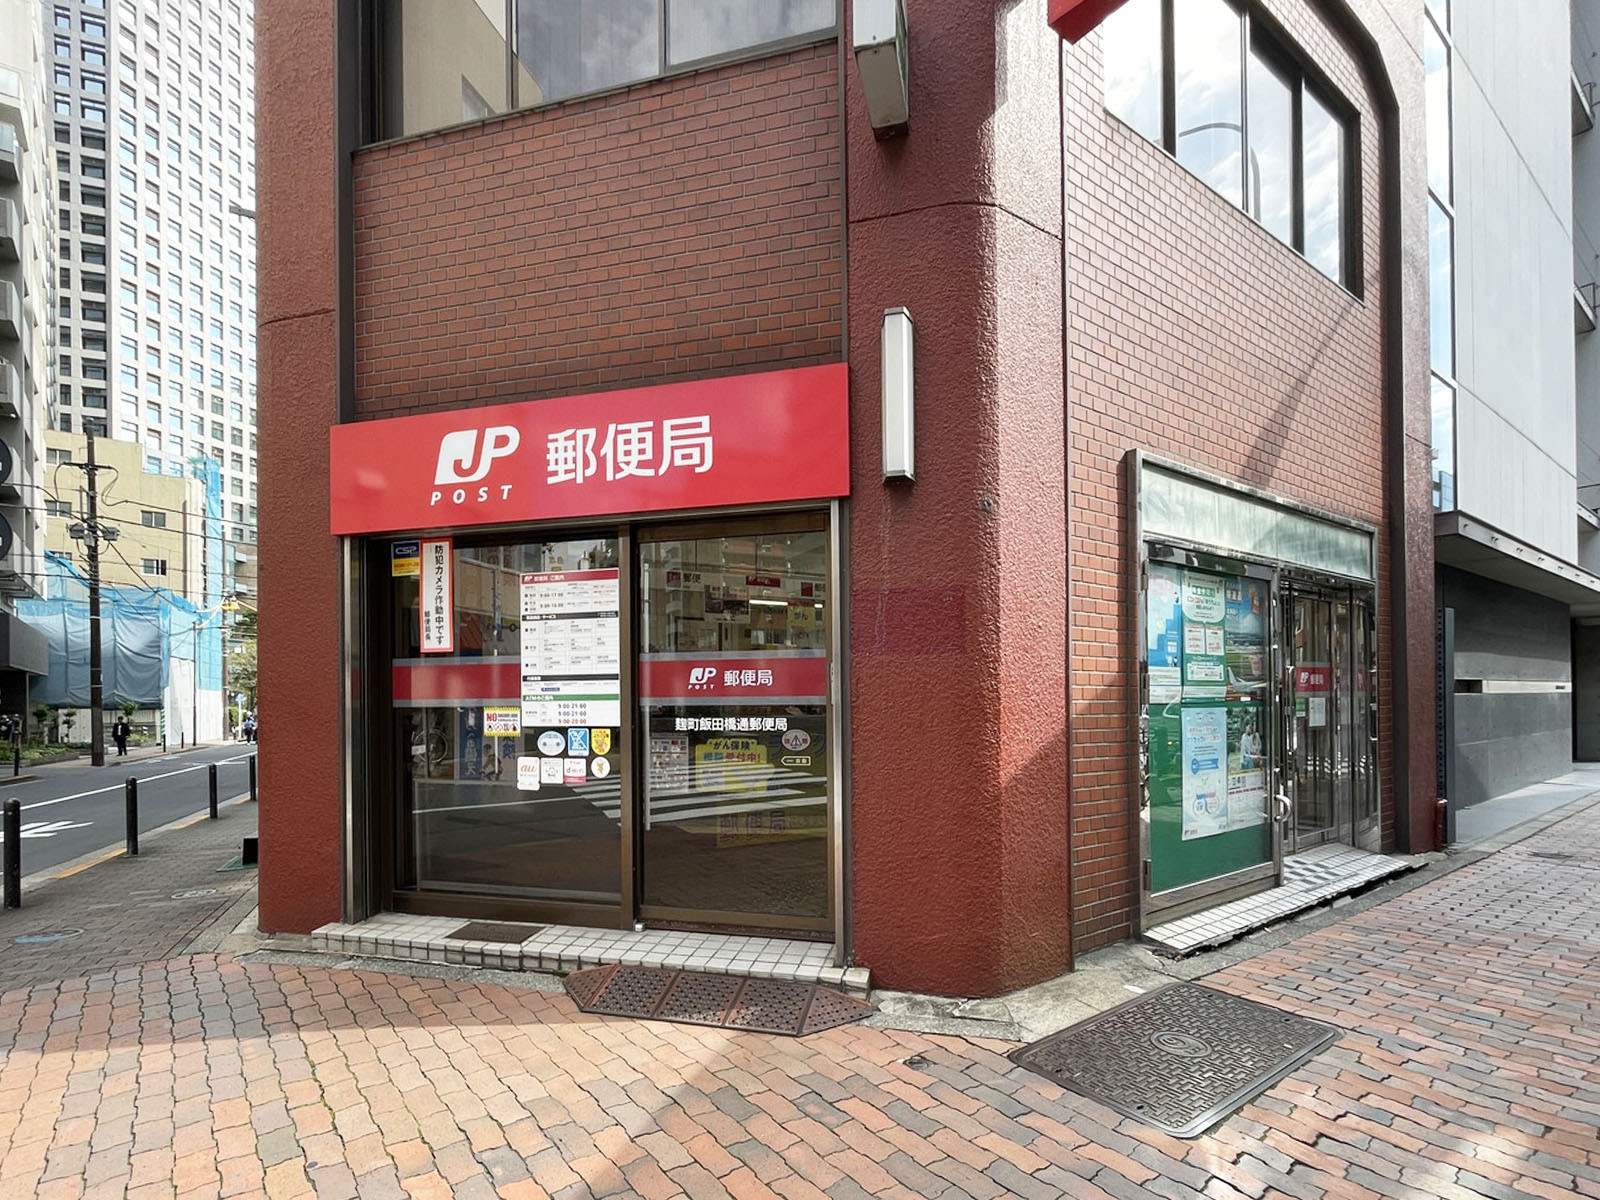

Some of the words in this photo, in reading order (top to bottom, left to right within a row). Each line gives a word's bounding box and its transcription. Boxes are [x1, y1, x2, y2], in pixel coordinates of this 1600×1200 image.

[434, 425, 520, 486] JP
[547, 415, 713, 484] 郵便局
[430, 484, 512, 506] POST
[434, 544, 444, 646] 防犯カメラ作動中です
[723, 669, 773, 687] 郵便局
[486, 713, 498, 722] NO
